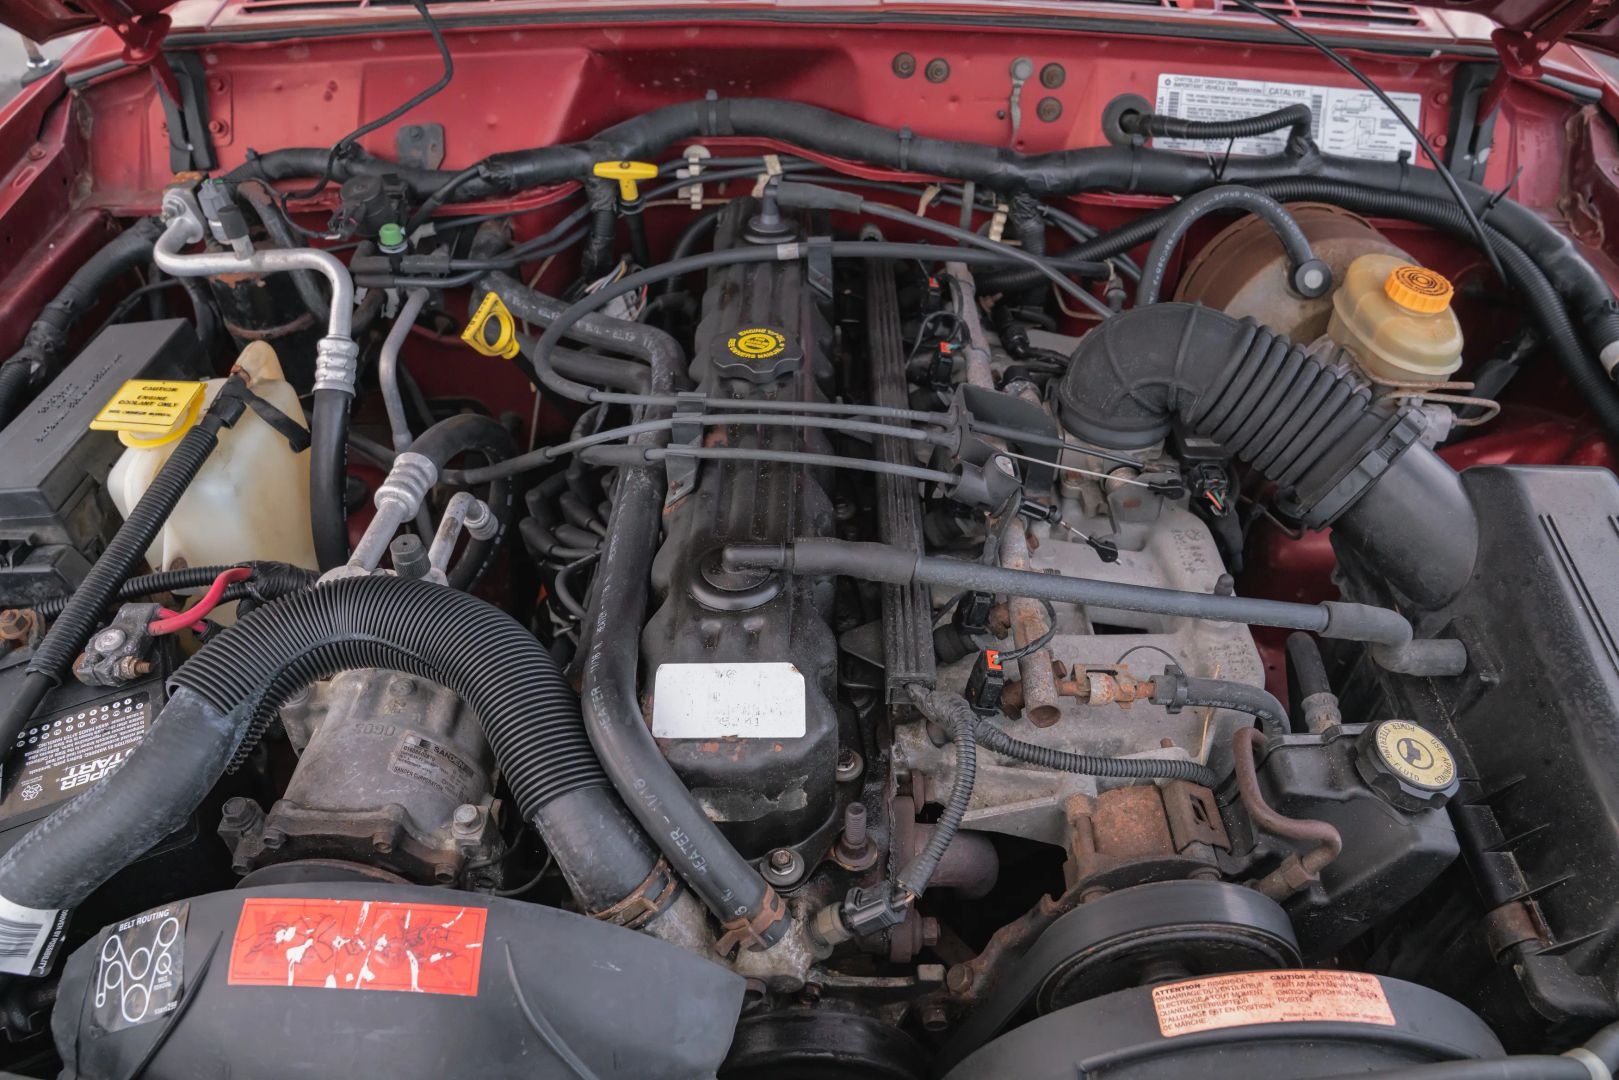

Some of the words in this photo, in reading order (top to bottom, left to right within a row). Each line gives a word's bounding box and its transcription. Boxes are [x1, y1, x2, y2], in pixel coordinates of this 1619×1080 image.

[1268, 87, 1305, 96] CATALYST
[1430, 739, 1445, 754] USE
[1379, 726, 1393, 759] STEERING
[1394, 762, 1420, 781] FLUID
[119, 920, 136, 931] BELT
[137, 909, 170, 925] ROUTING
[1155, 984, 1200, 996] ATTENTION
[1160, 1007, 1185, 1017] QUAND
